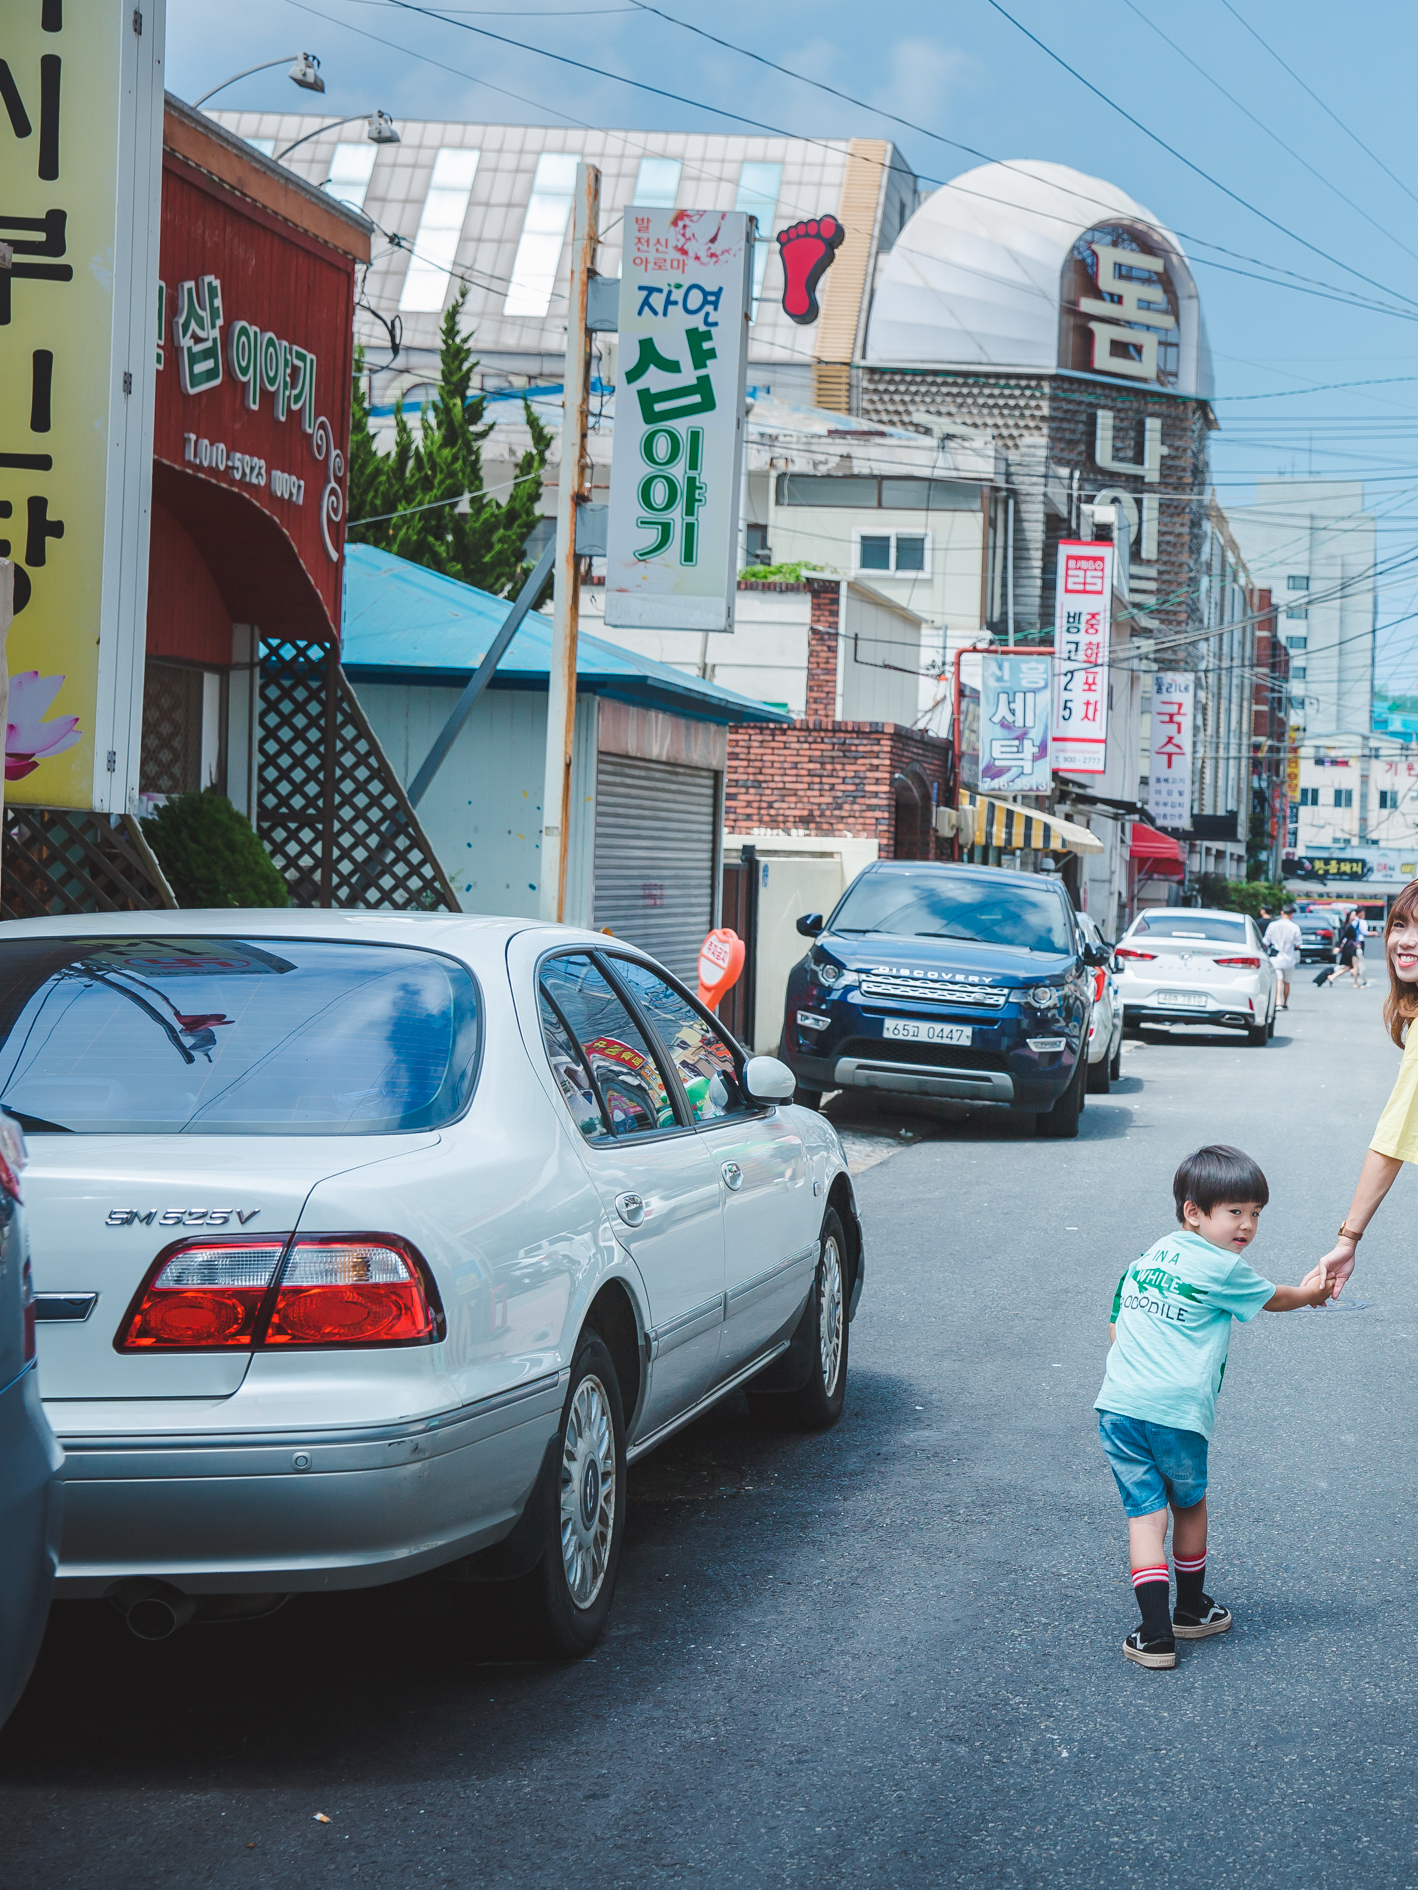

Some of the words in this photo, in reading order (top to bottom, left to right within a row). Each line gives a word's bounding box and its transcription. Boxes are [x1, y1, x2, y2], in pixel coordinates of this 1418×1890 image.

[635, 216, 653, 234] 발
[634, 236, 669, 254] 전신
[632, 256, 688, 275] 아로마
[637, 282, 723, 328] 자연
[1068, 559, 1103, 570] BINGO
[1067, 569, 1103, 591] 25
[989, 691, 1040, 776] 세탁
[1155, 701, 1187, 769] 국수
[879, 966, 993, 984] DISCOVERY
[927, 1026, 964, 1042] 0447
[1168, 1252, 1180, 1266] A
[1137, 1269, 1183, 1294] WHILE
